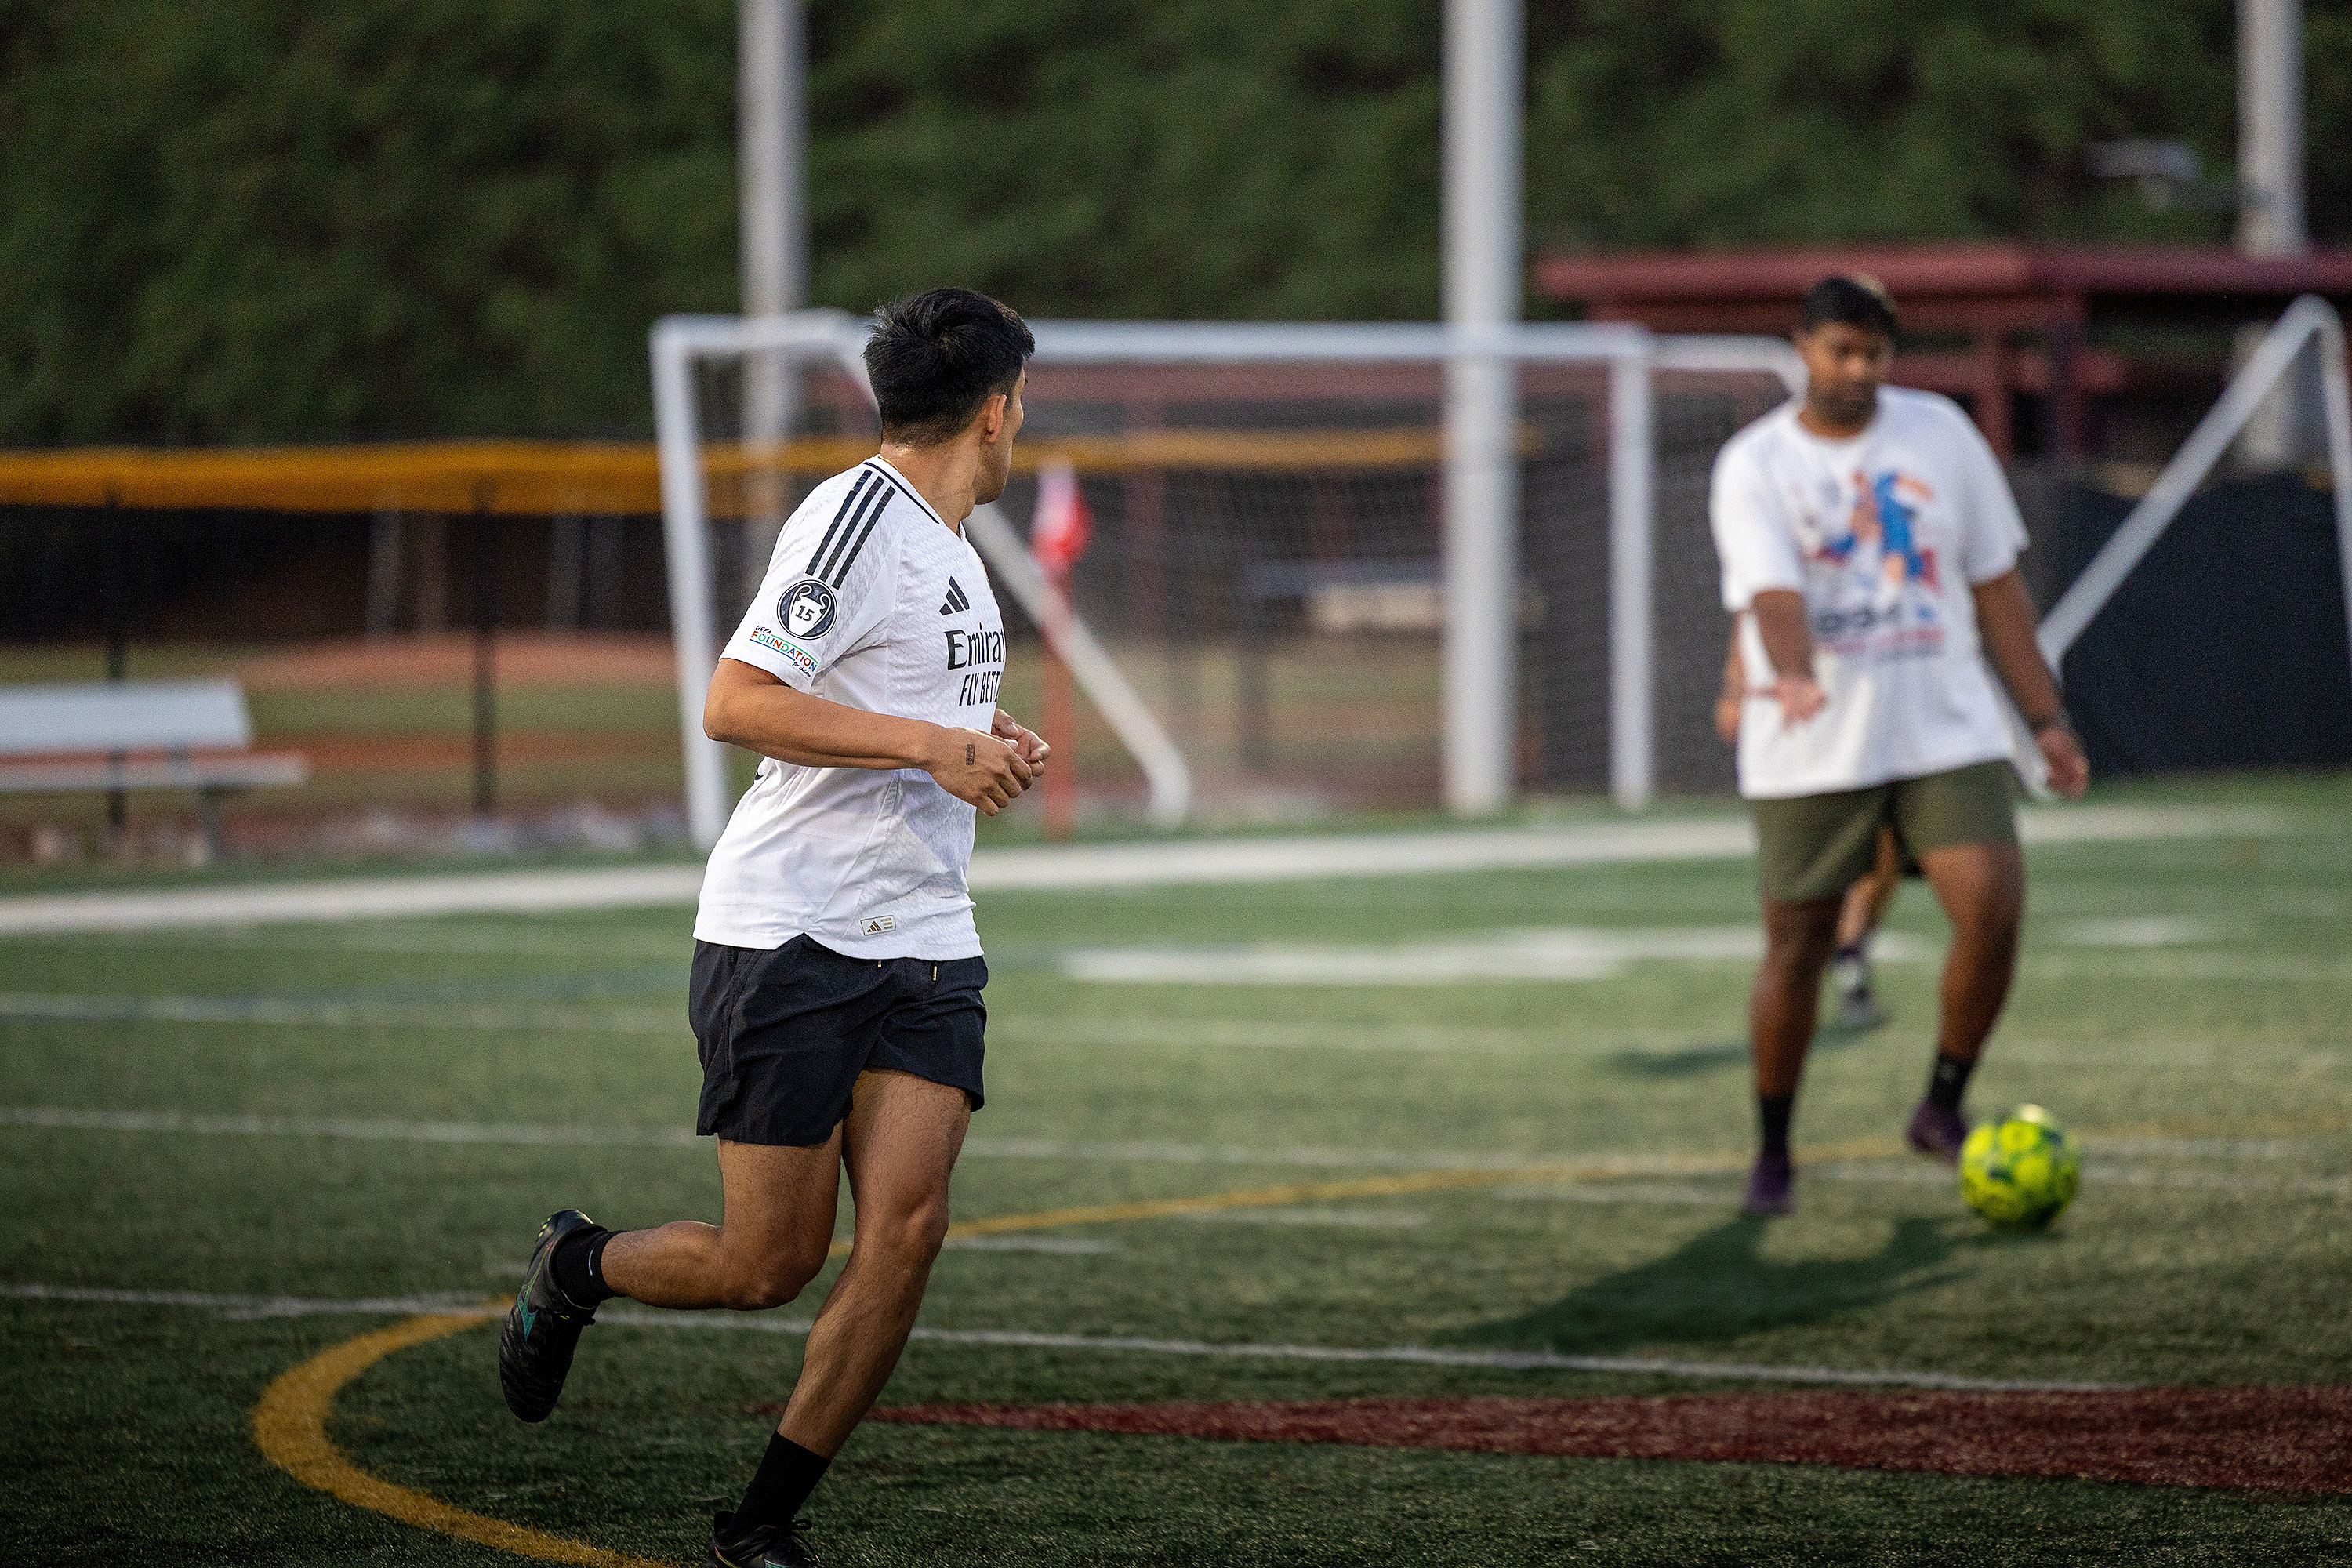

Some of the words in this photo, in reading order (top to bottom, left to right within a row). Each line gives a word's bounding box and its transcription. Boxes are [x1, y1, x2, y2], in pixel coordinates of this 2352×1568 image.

[795, 605, 815, 622] 15
[755, 625, 771, 634] UEFA
[959, 673, 979, 706] FLY
